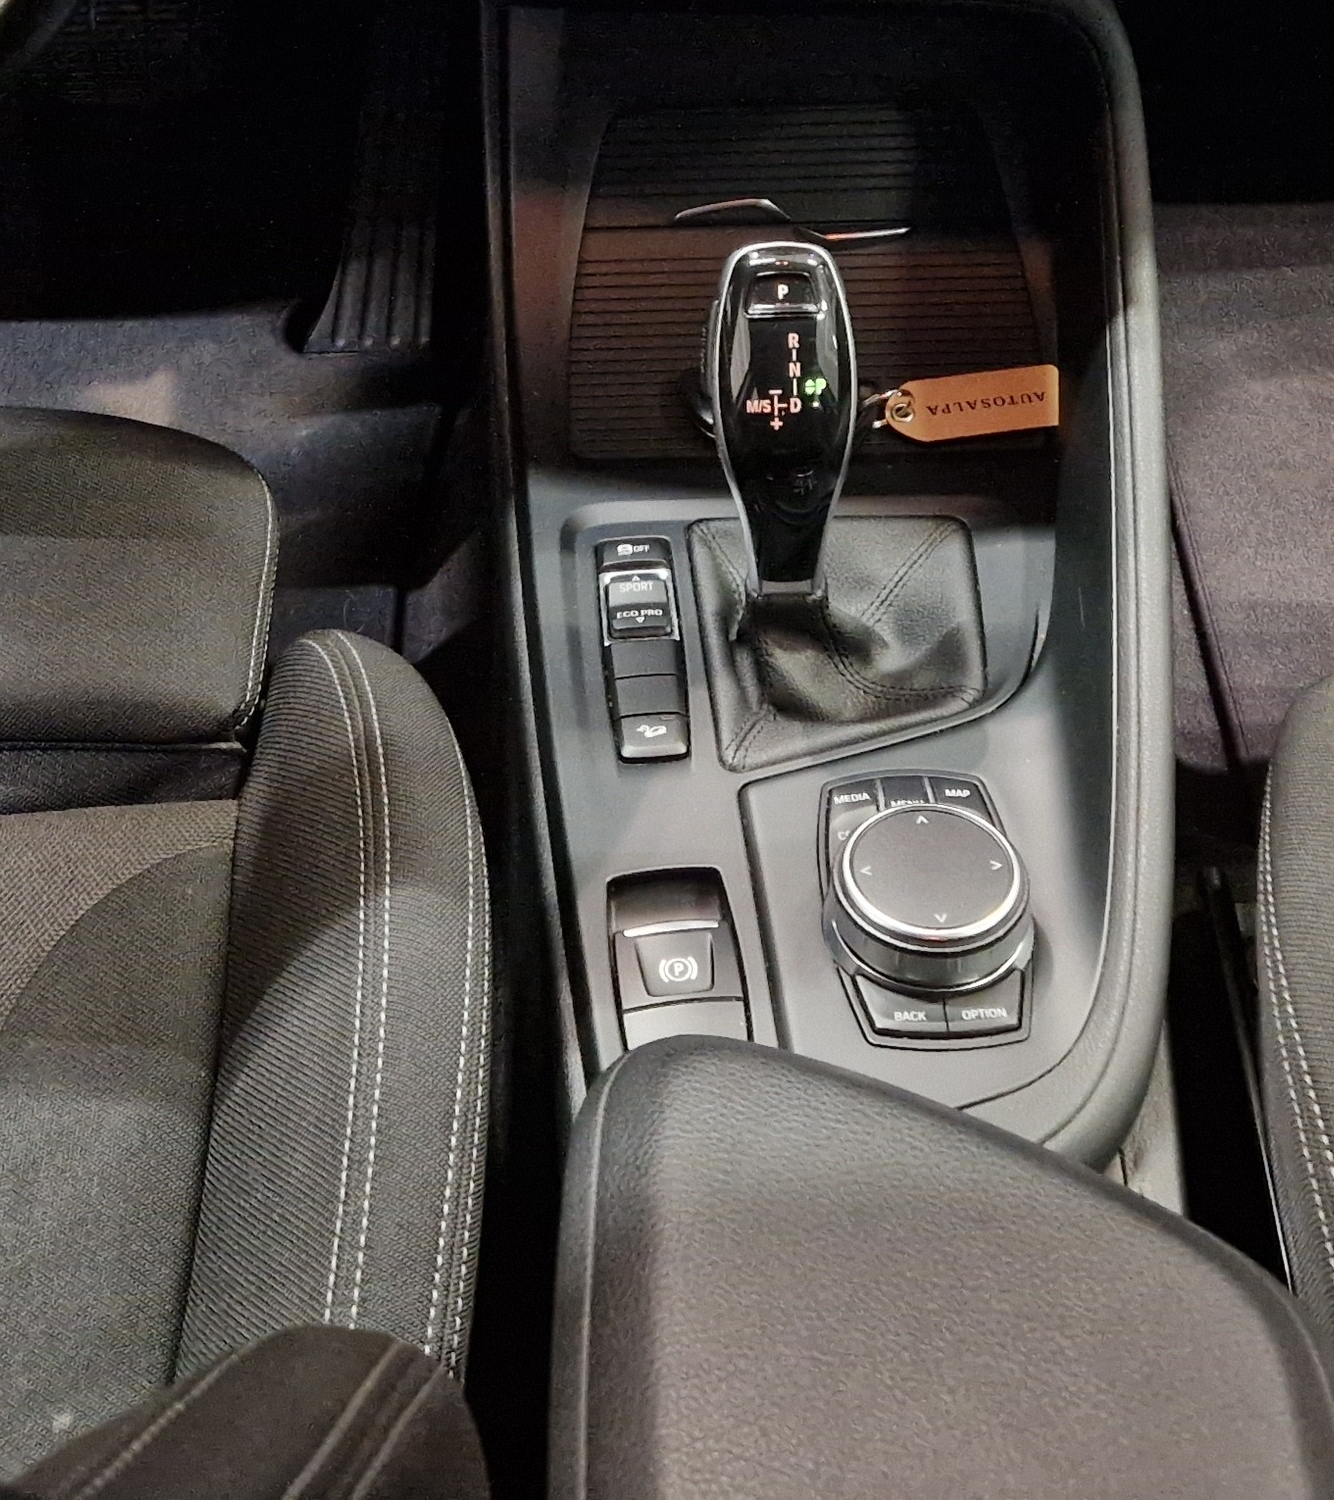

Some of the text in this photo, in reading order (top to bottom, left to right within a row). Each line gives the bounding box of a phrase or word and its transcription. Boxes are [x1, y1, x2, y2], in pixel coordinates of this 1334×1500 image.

[777, 284, 789, 300] P
[787, 333, 800, 349] R
[788, 362, 802, 378] N
[746, 400, 771, 414] M/S
[789, 397, 803, 414] D
[926, 391, 1046, 416] AUTOSALPA
[619, 581, 654, 593] SPORT
[616, 608, 663, 619] ECO PRO
[833, 791, 872, 805] MEDIA
[944, 788, 971, 798] MAP
[893, 1011, 927, 1021] BACK
[961, 1008, 1008, 1020] OPTION
